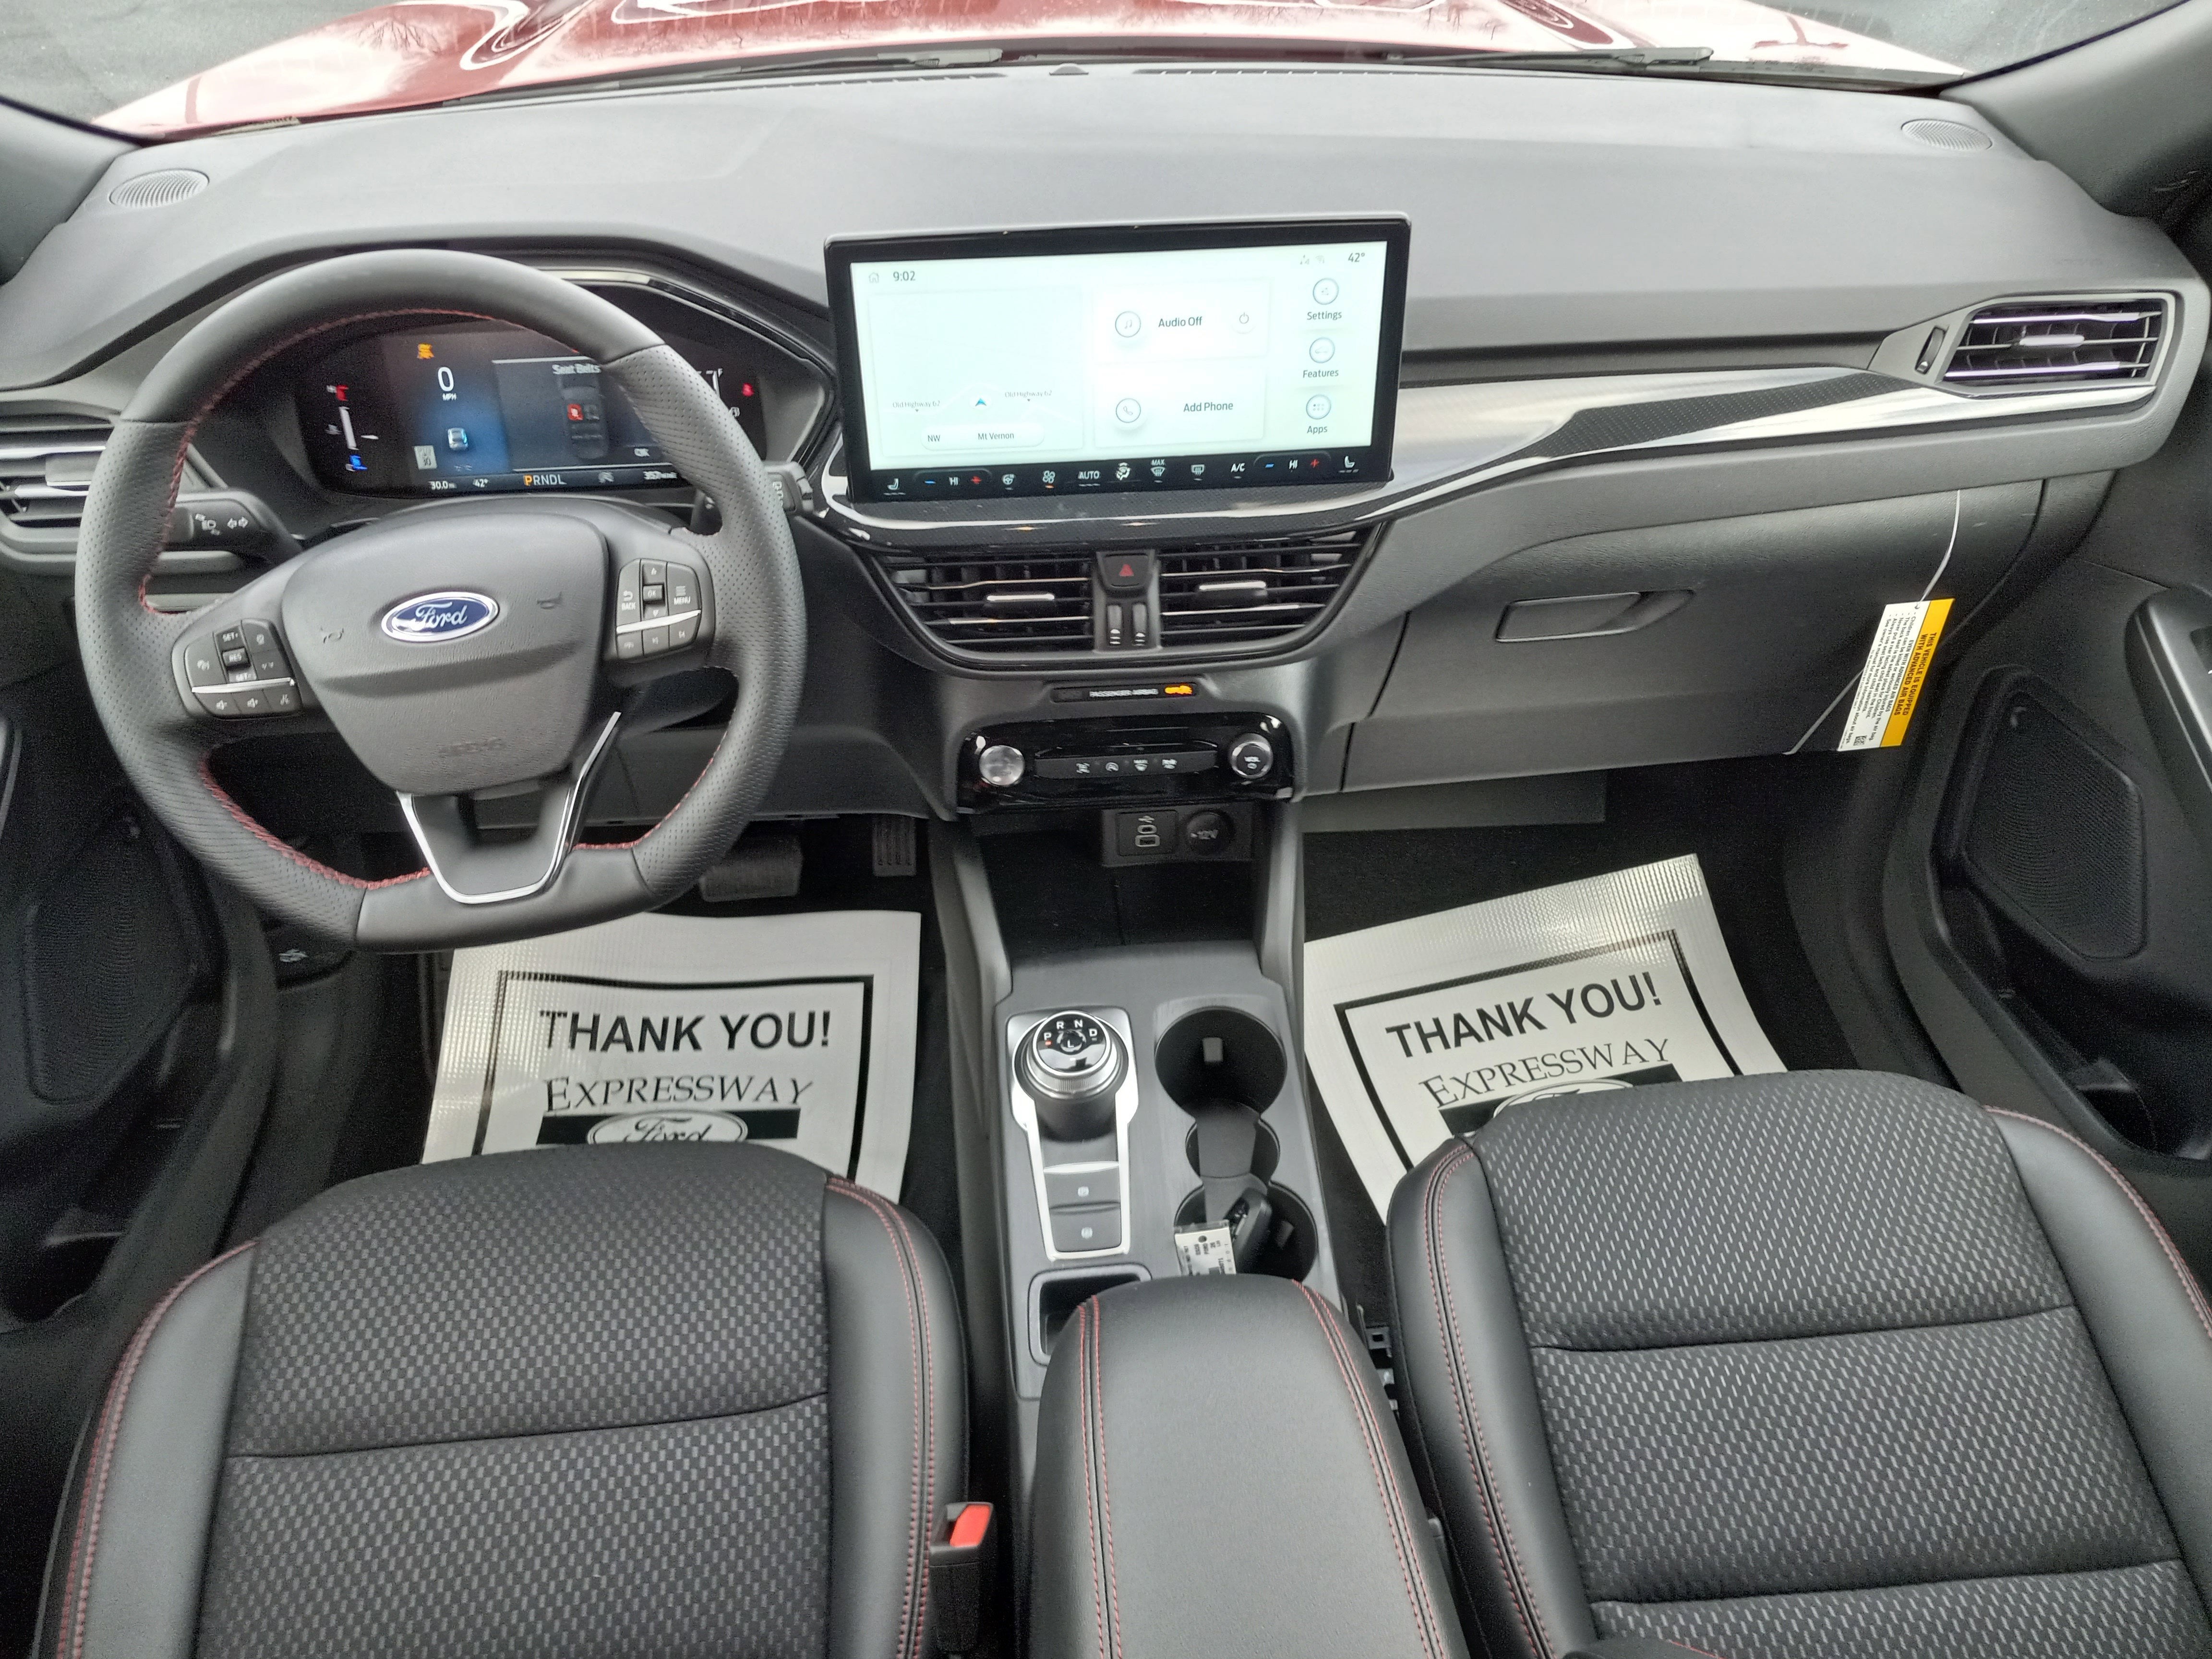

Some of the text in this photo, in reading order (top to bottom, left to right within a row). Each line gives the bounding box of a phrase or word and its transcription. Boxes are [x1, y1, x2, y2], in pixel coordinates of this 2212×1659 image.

[1348, 252, 1365, 263] 42°
[893, 271, 915, 281] 9:02
[1158, 316, 1202, 327] Audio Off
[1307, 311, 1342, 321] Settings
[1302, 368, 1339, 378] Features
[437, 366, 454, 392] 0
[1183, 401, 1233, 412] Add Phone
[1307, 424, 1328, 434] Apps
[1231, 463, 1245, 472] A/C
[1289, 460, 1298, 469] HI
[524, 474, 567, 486] PRNDL
[1079, 471, 1100, 480] AUTO
[949, 477, 958, 486] HI
[648, 589, 656, 597] OK
[673, 596, 691, 605] MENU
[621, 602, 636, 611] BACK
[413, 601, 468, 629] Ford
[1925, 632, 1936, 647] THIS
[1905, 639, 1914, 652] EVEN
[1900, 653, 1909, 665] WITH
[1915, 649, 1931, 675] VEHICLE
[1892, 666, 1905, 689] ADVANCED
[1893, 634, 1928, 715] WITH ADVANCED AIR BAGS
[1885, 700, 1893, 712] BAGS
[1901, 685, 1918, 716] EQUIPPED
[1385, 971, 1662, 1059] THANK YOU!
[1057, 1021, 1064, 1029] R
[1074, 1019, 1083, 1028] N
[539, 1010, 831, 1052] THANK YOU!
[1044, 1032, 1052, 1040] P
[1089, 1028, 1098, 1036] D
[1067, 1040, 1074, 1048] L
[1419, 1038, 1670, 1108] EXPRESSWAY
[542, 1076, 813, 1113] EXPRESSWAY
